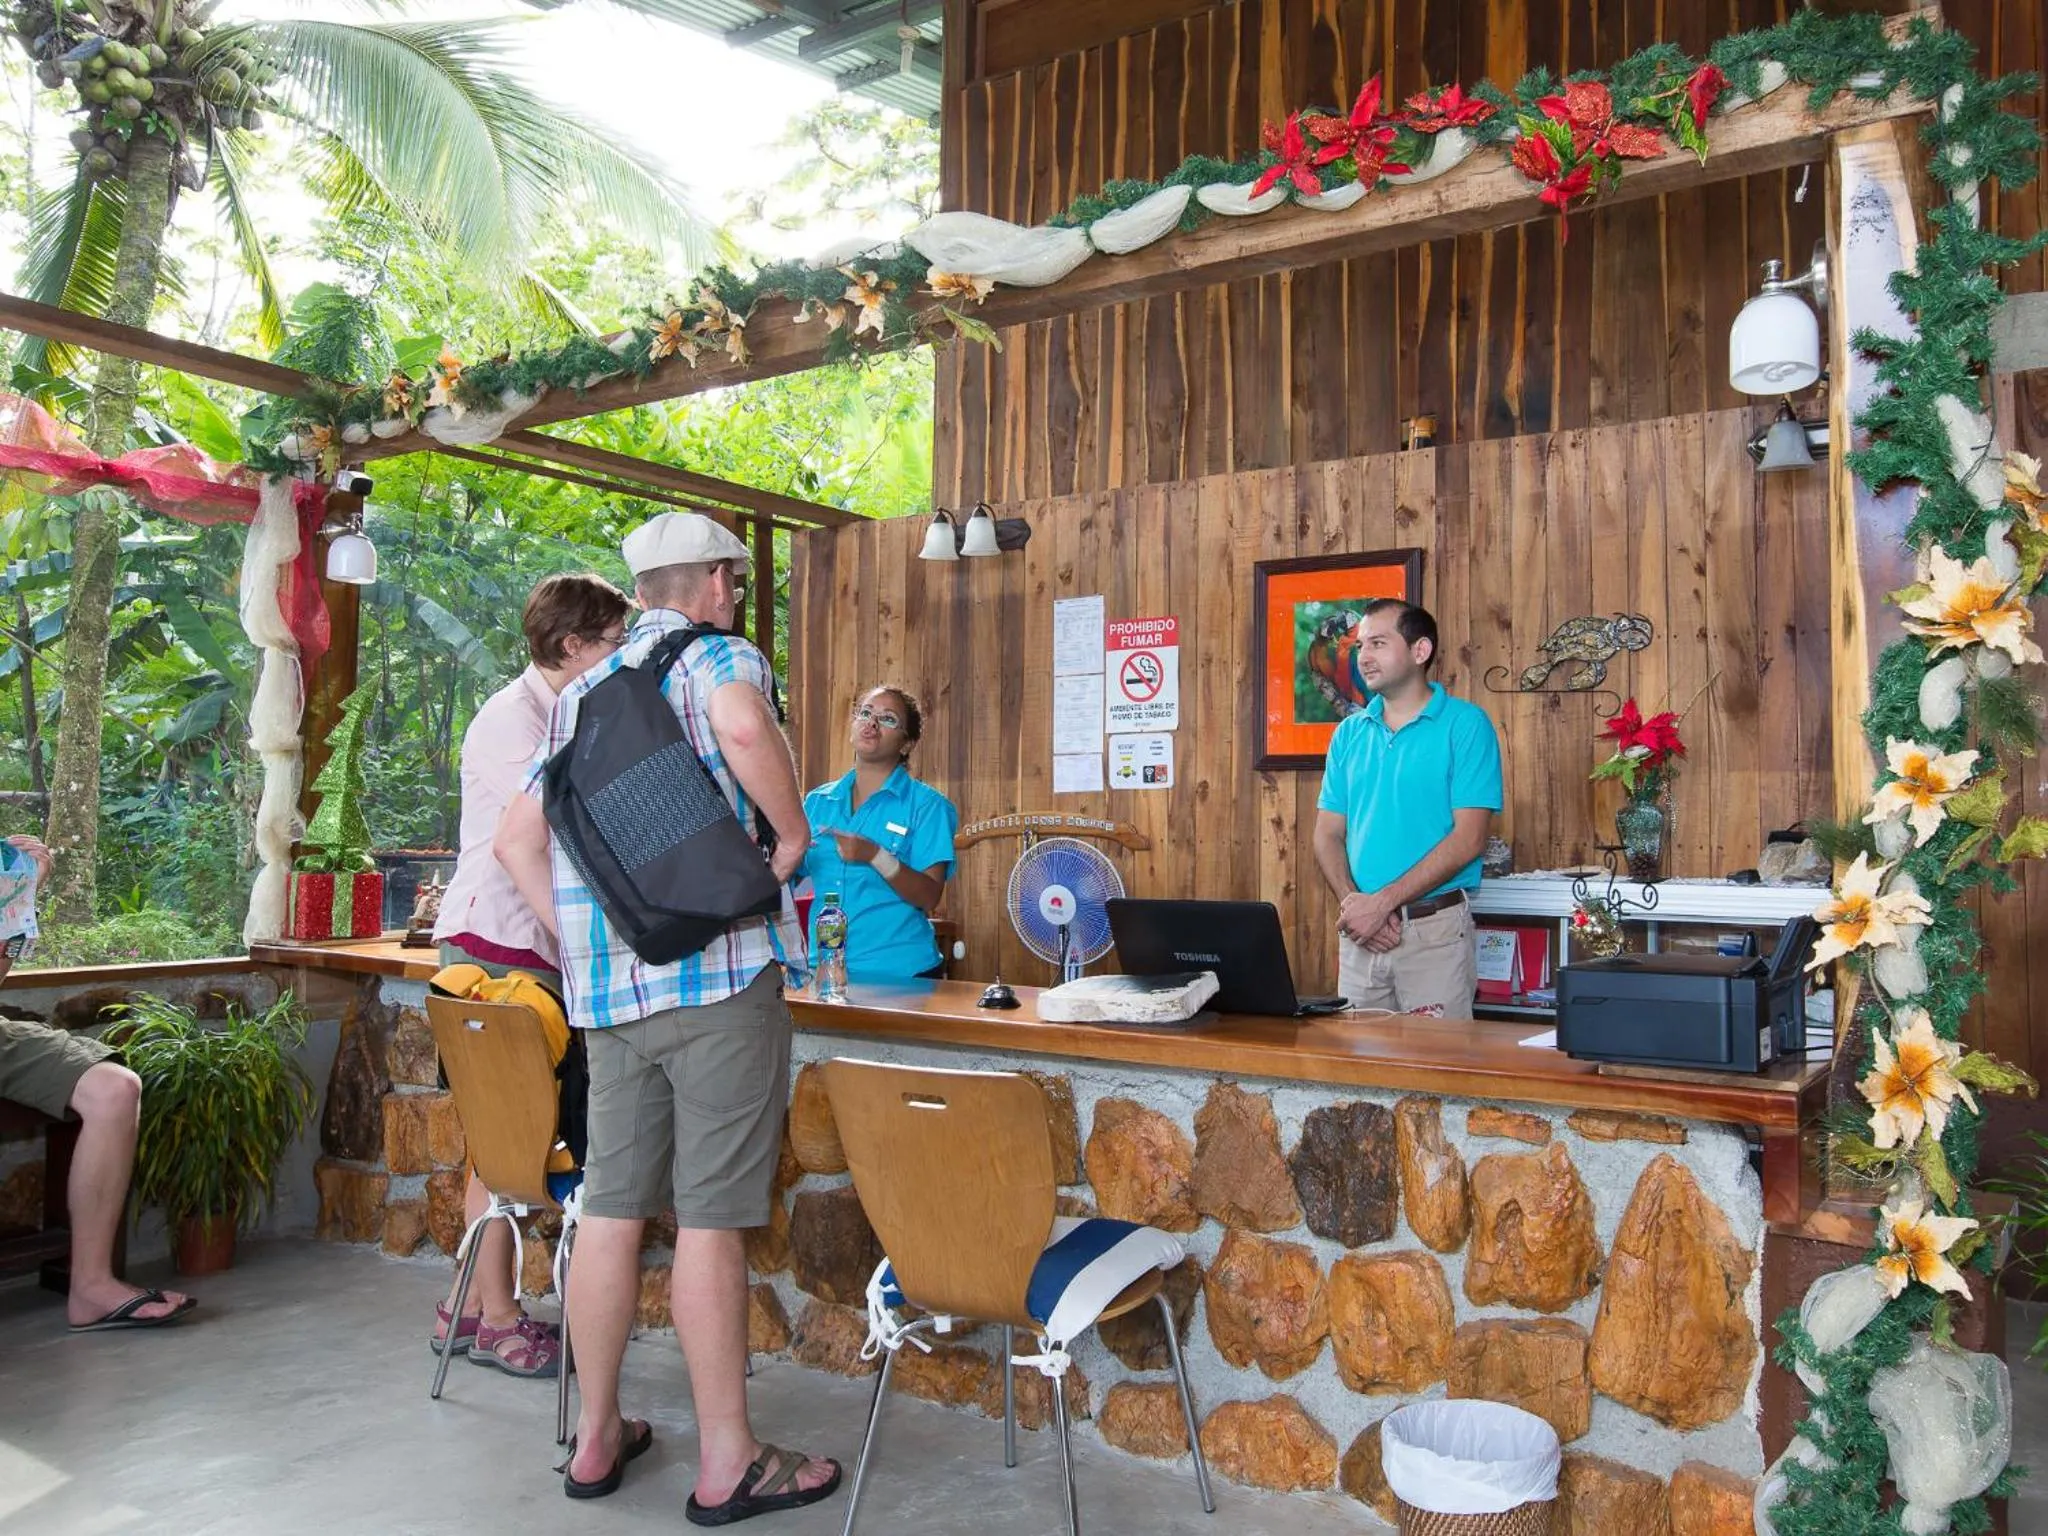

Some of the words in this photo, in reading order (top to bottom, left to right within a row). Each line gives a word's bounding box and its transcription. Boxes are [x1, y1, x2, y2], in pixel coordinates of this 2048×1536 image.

[1109, 618, 1176, 636] PROHIBIDO
[1120, 633, 1163, 648] FUMAR
[1165, 702, 1175, 710] DE
[1112, 712, 1132, 720] HUMO
[1173, 952, 1221, 963] TOSHIBA
